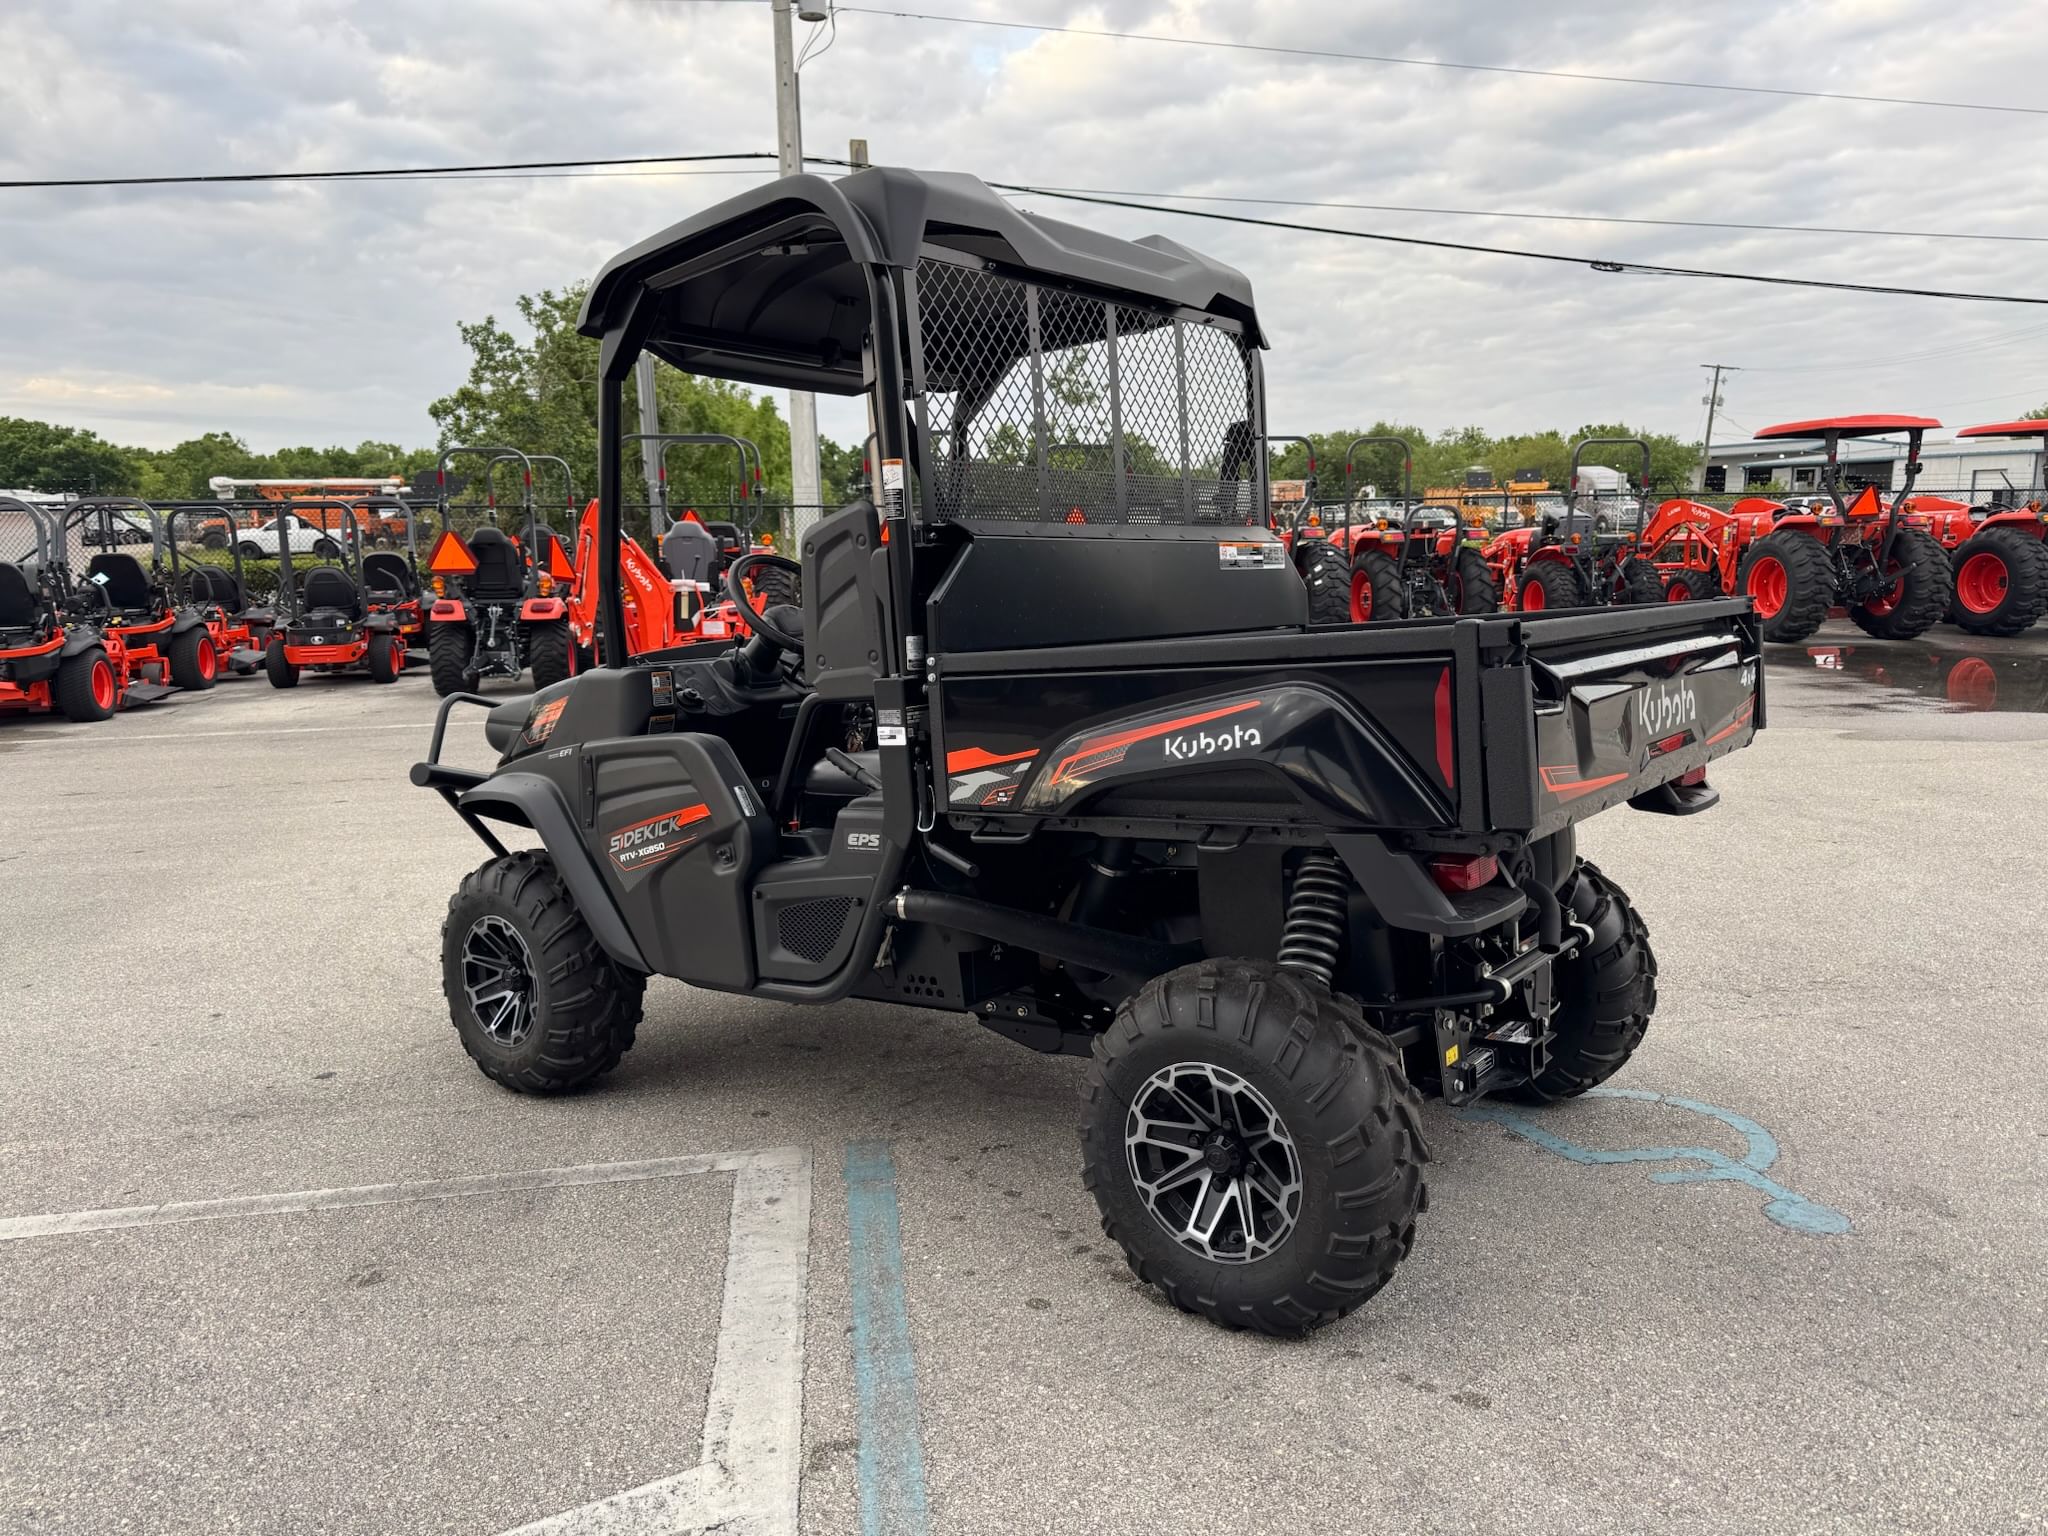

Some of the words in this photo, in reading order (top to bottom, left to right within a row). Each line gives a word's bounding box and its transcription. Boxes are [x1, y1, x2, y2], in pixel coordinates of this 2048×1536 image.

[625, 558, 653, 592] Kubota
[1639, 679, 1696, 736] Kubota
[1165, 724, 1261, 760] Kubota
[609, 813, 682, 854] SIDEKICK
[847, 833, 881, 847] EPS
